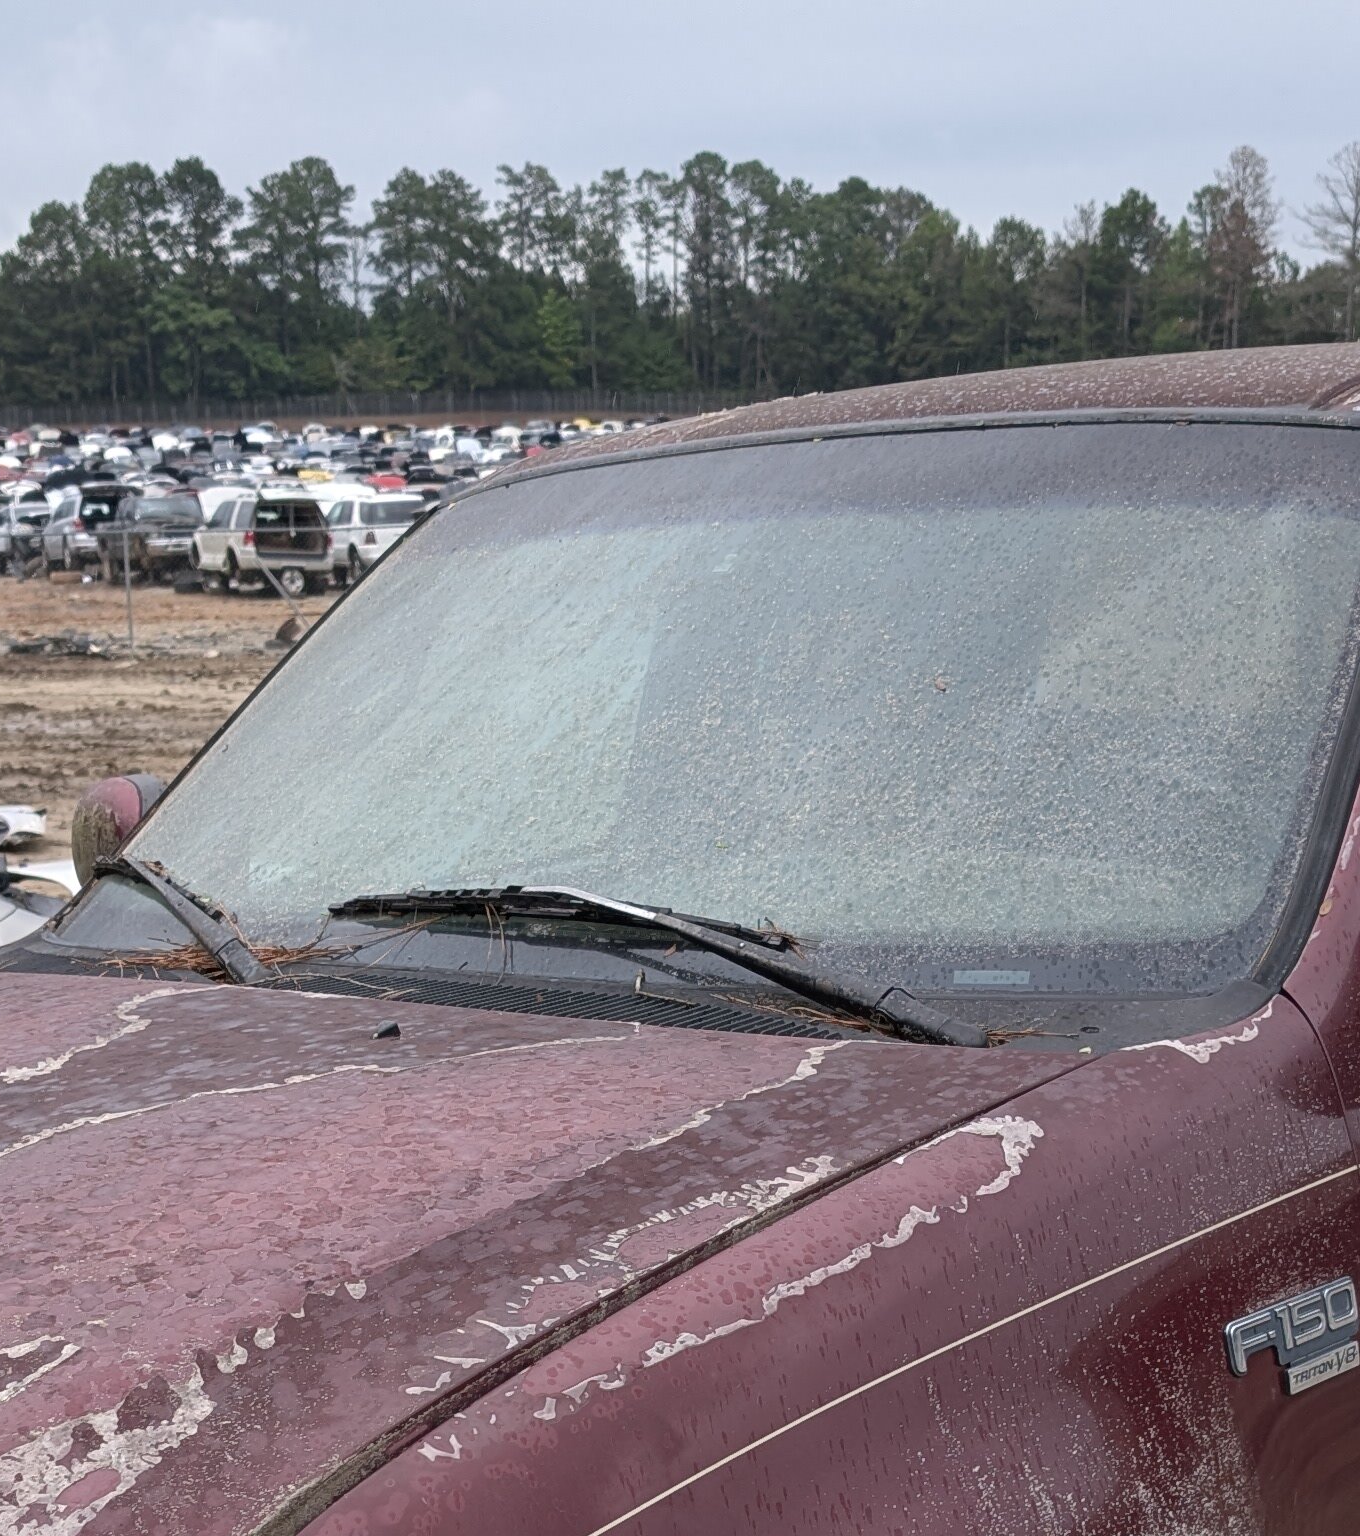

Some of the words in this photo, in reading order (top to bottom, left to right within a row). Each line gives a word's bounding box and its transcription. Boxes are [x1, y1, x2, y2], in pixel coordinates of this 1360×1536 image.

[1229, 1279, 1359, 1374] F-150
[1292, 1359, 1334, 1385] TRITON
[1335, 1345, 1358, 1373] V8
